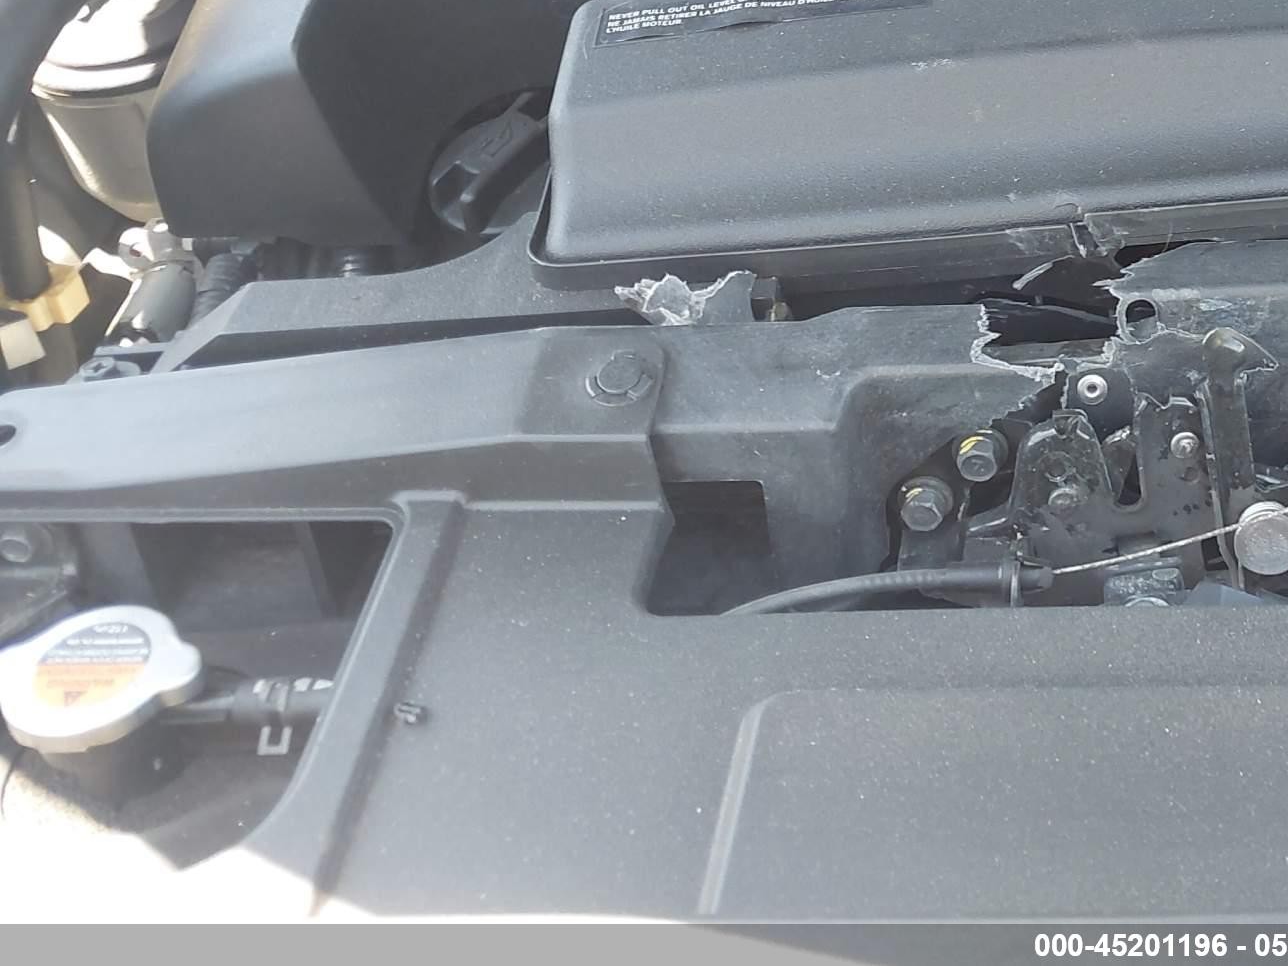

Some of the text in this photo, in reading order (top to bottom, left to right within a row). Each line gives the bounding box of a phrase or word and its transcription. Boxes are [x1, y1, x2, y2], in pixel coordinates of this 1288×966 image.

[607, 20, 620, 28] NE
[622, 15, 656, 26] JAMAIS
[657, 11, 698, 21] RETIRER
[699, 9, 712, 17] LA
[713, 4, 743, 15] JAUGE
[760, 0, 796, 7] NIVEAU
[608, 10, 640, 20] NEVER
[641, 8, 665, 17] PULL
[667, 6, 688, 14] OUT
[709, 0, 736, 9] LEVEL
